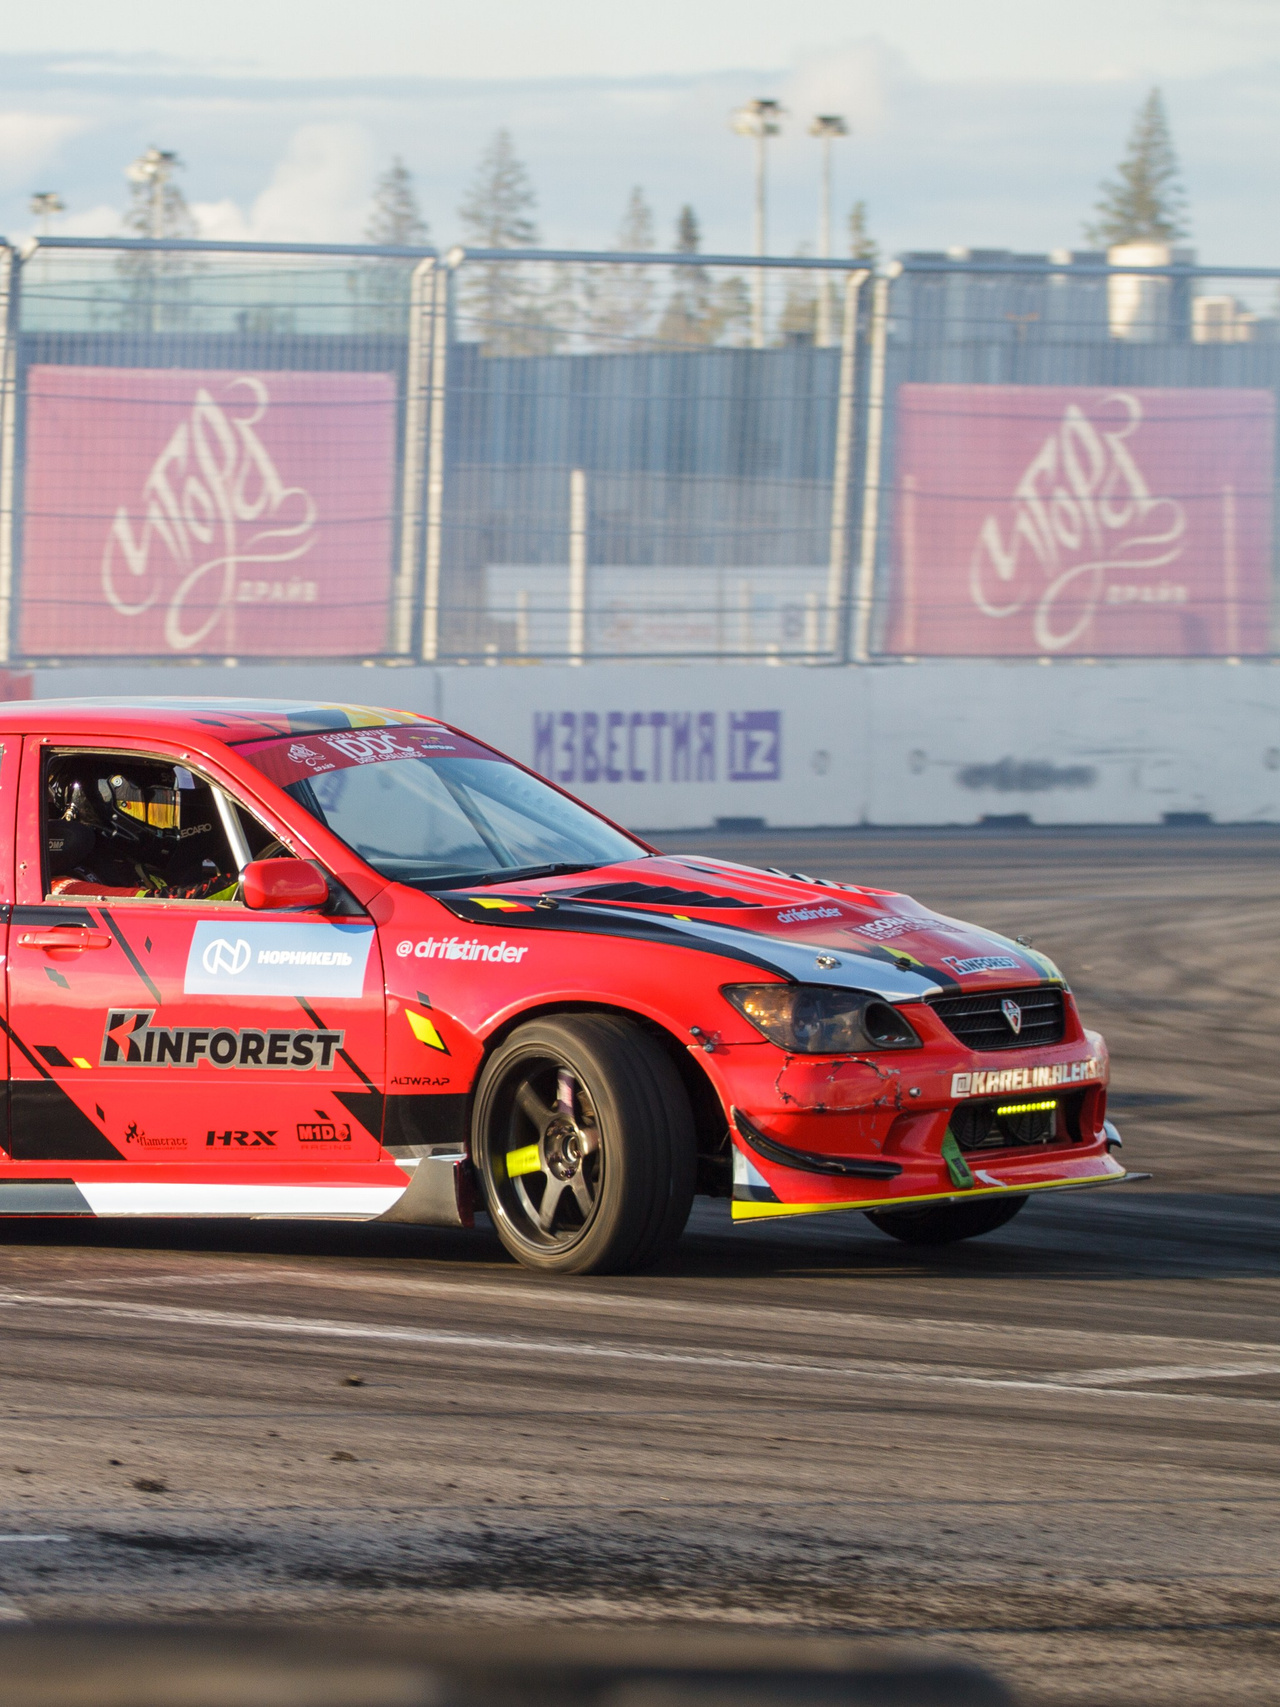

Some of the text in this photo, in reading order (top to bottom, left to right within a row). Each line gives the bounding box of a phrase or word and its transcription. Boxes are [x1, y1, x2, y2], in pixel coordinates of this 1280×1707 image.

[318, 728, 391, 743] IGORA DRIVE
[532, 711, 716, 783] ИЗВЕСТИЯ
[354, 755, 381, 765] DRIFT
[180, 823, 212, 839] ECARO
[257, 949, 352, 966] НОРНИКЕЛЬ
[944, 957, 1019, 975] KINFOREST
[103, 1012, 341, 1067] KINFOREST
[206, 1131, 280, 1146] HRX
